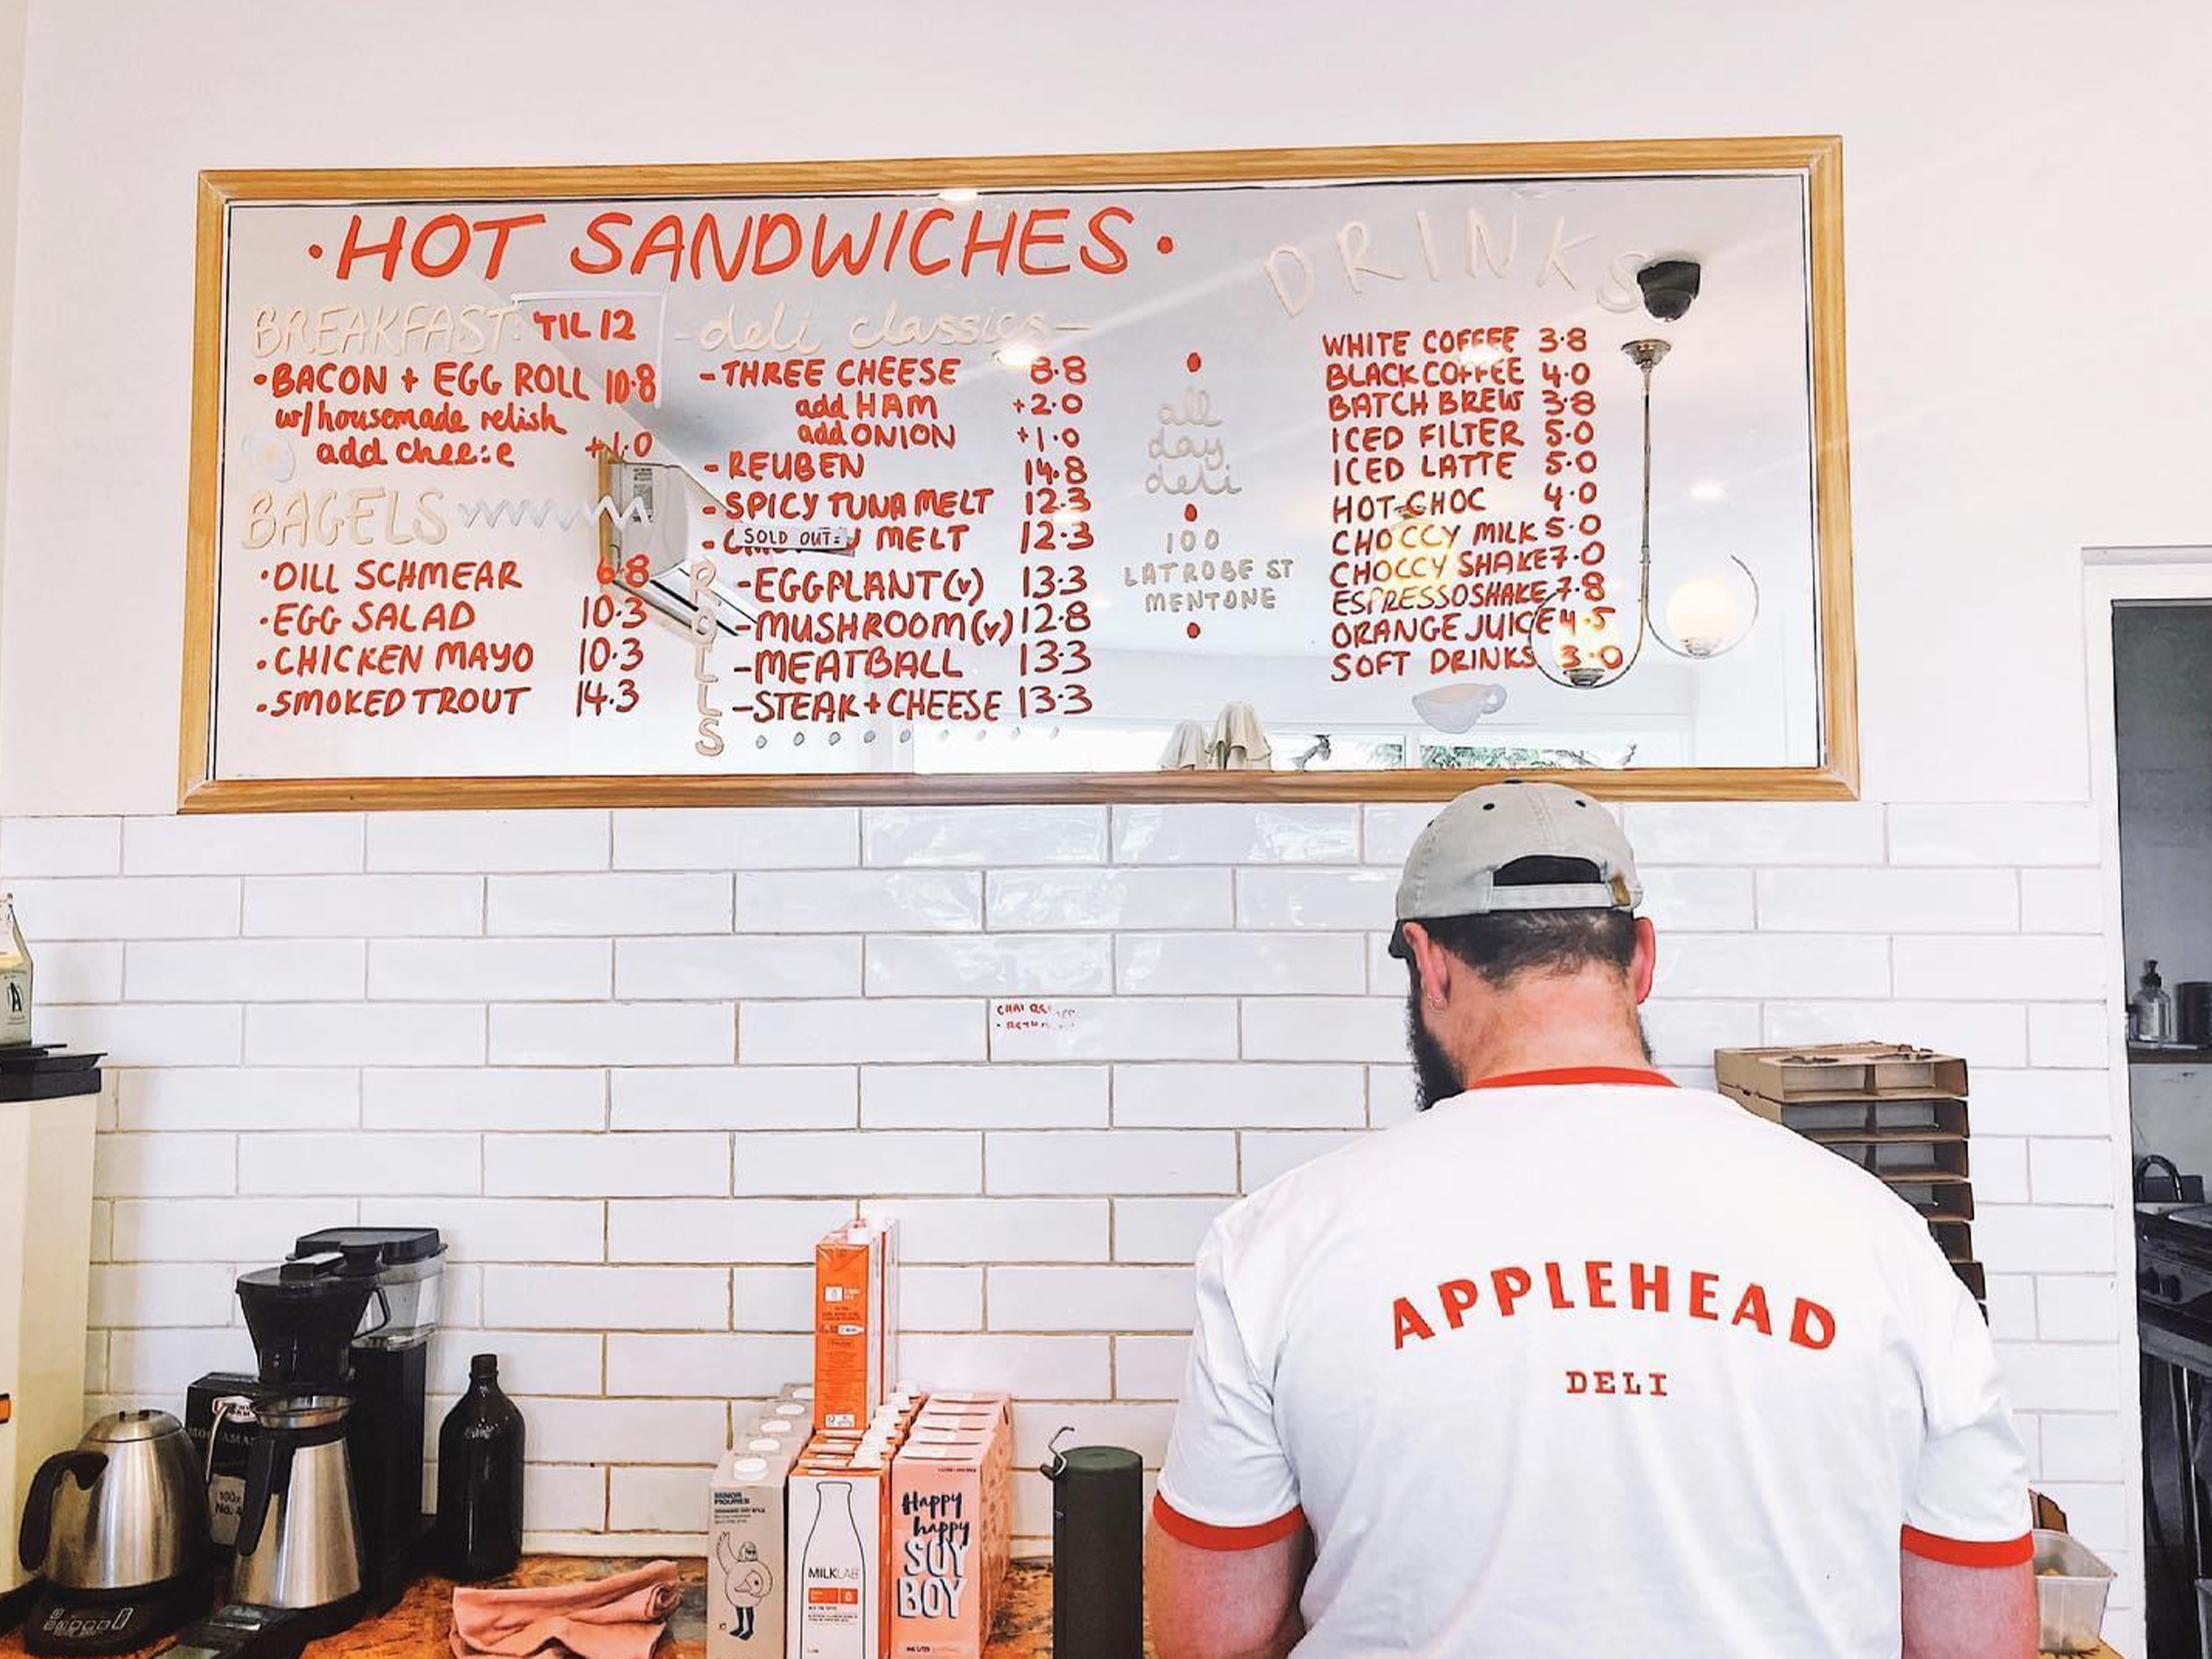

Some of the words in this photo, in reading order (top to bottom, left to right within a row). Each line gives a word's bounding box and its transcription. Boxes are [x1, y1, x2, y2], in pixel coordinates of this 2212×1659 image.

[336, 214, 546, 281] HOT
[569, 206, 1136, 283] SANDWICHES
[1263, 207, 1651, 318] DRINKS
[532, 309, 593, 342] TIL
[598, 307, 636, 342] 12
[700, 302, 823, 354] deli
[849, 300, 1046, 348] classics
[1322, 329, 1412, 359] WHITE
[1421, 325, 1520, 357] COFFEE
[1537, 326, 1589, 354] 3.8
[270, 361, 388, 399] BACON
[432, 359, 503, 399] EGG
[512, 362, 591, 402] ROLL
[603, 362, 658, 406] 10.8
[719, 357, 827, 390] THREE
[834, 354, 963, 389] CHEESE
[1326, 361, 1419, 392] BLACK
[1421, 356, 1524, 388] COFFEE
[1540, 361, 1591, 387] 4.0
[274, 399, 470, 438] w/housemade
[479, 402, 569, 437] relish
[794, 392, 850, 422] add
[855, 390, 938, 421] HAM
[1157, 386, 1223, 426] all
[1327, 392, 1429, 423] BATCH
[1438, 388, 1524, 416] BREW
[315, 436, 388, 469] add
[796, 423, 848, 447] add
[849, 421, 957, 451] ONION
[1148, 427, 1224, 470] day
[1331, 425, 1404, 453] ICED
[1418, 418, 1524, 449] FILTER
[1544, 417, 1595, 448] 5.0
[727, 451, 865, 484] REUBEN
[1145, 464, 1242, 495] deli
[1333, 457, 1404, 487] ICED
[1420, 450, 1516, 480] LATTE
[1544, 450, 1598, 477] 5.0
[241, 487, 449, 550] BAGELS
[723, 491, 820, 523] SPICY
[827, 491, 907, 522] TUNA
[914, 488, 995, 519] MELT
[1332, 495, 1394, 524] HOT
[1403, 488, 1485, 518] CHOC
[1542, 481, 1597, 511] 4.0
[745, 528, 788, 545] SOLD
[875, 523, 970, 553] MELT
[1020, 519, 1095, 554] 12.3
[1167, 529, 1219, 554] 100
[1331, 523, 1461, 556] CHOCCY
[1472, 522, 1536, 545] MILK
[1544, 513, 1601, 540] 5.0
[273, 561, 339, 595] DILL
[354, 558, 524, 593] SCHMEAR
[1023, 565, 1087, 599] 13.3
[1266, 559, 1293, 579] ST
[1329, 555, 1445, 588] CHOCCY
[1457, 547, 1546, 579] SHAKE
[272, 601, 342, 638] EGG
[350, 599, 477, 634] SALAD
[581, 595, 650, 630] 10.3
[1024, 601, 1091, 632] 12.8
[1145, 587, 1276, 613] MENTONE
[1331, 613, 1459, 648] ORANGE
[1465, 608, 1553, 642] JUICE
[273, 642, 425, 678] CHICKEN
[435, 640, 534, 674] MAYO
[579, 636, 644, 673] 10.3
[755, 646, 961, 685] MEATBALL
[1020, 640, 1091, 675] 13.3
[1331, 650, 1411, 682] SOFT
[1430, 645, 1536, 676] DRINKS
[269, 687, 407, 718] SMOKED
[411, 686, 532, 713] TROUT
[576, 679, 640, 716] 14.3
[1019, 685, 1092, 718] 13.3
[1392, 1260, 1837, 1351] APPLEHEAD
[1566, 1370, 1666, 1398] DELI
[902, 1491, 962, 1520] Happy
[913, 1516, 970, 1546] happy
[808, 1567, 859, 1579] MILKLAB
[904, 1537, 969, 1577] SOY
[897, 1577, 968, 1619] BOY
